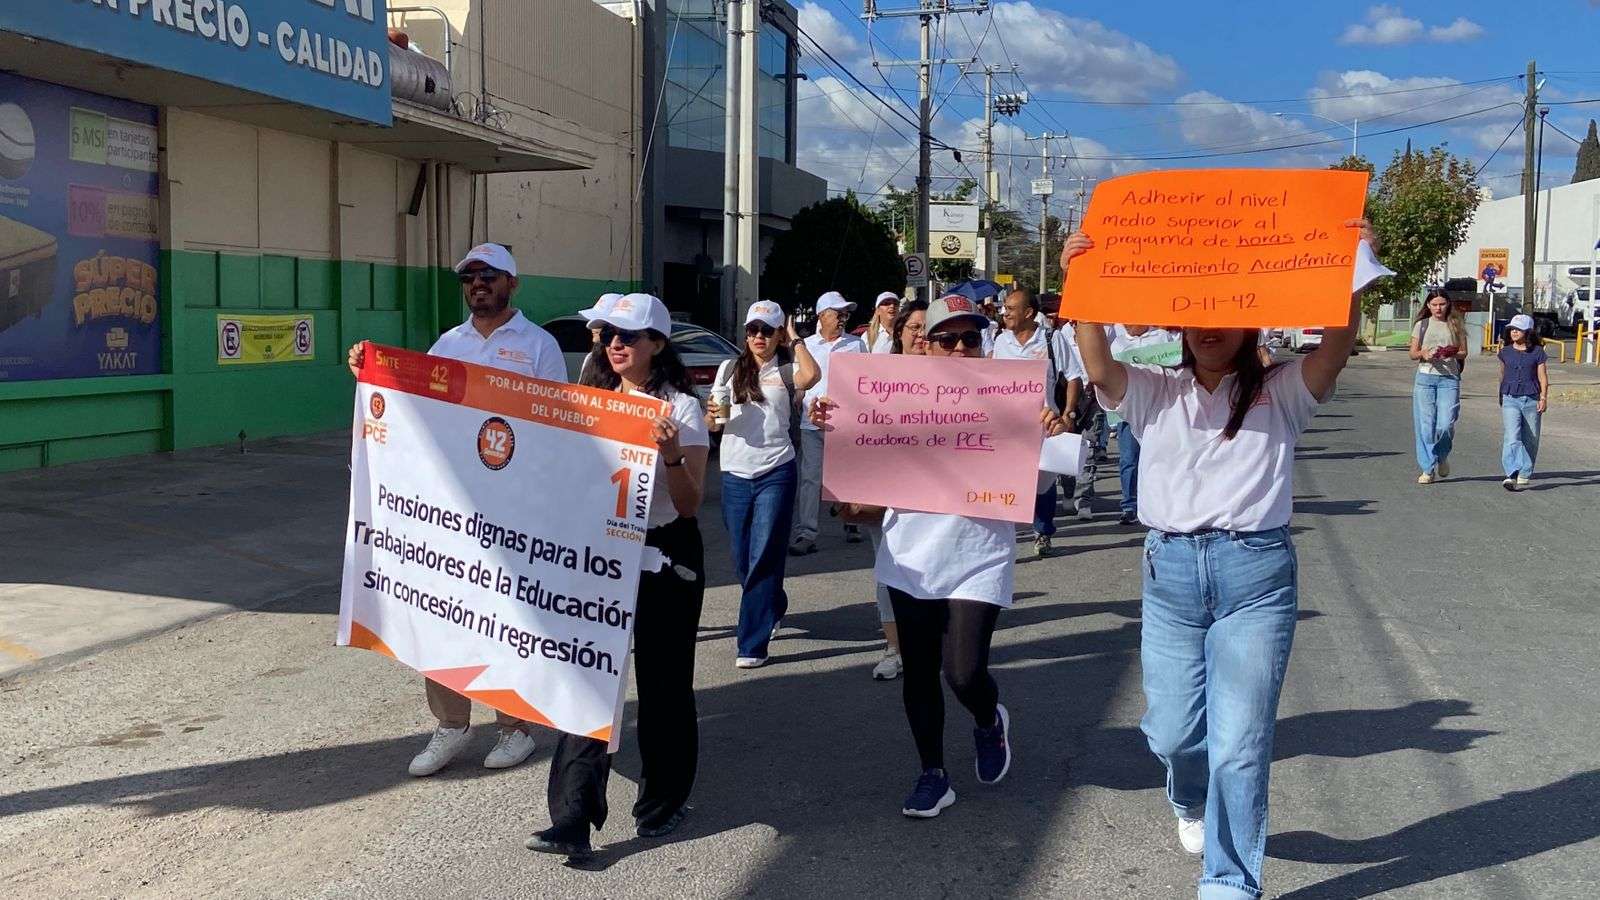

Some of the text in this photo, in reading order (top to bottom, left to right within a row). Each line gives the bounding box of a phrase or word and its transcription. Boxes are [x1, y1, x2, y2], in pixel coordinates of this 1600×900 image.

[277, 21, 383, 87] CALIDAD
[72, 126, 105, 150] 6 MSI
[1121, 189, 1287, 207] Adherir al nivel
[1102, 212, 1277, 235] medio superior al
[1203, 234, 1228, 248] de
[1238, 231, 1295, 246] horas
[1304, 228, 1329, 242] de
[1102, 253, 1352, 276] Fortalecimiento Académico
[73, 286, 158, 328] PRECIO
[97, 352, 138, 370] YAKAT
[431, 365, 448, 383] 42
[512, 380, 525, 392] LA
[526, 383, 587, 404] EDUCACIÓN
[590, 395, 603, 409] AL
[607, 399, 656, 420] SERVICIO
[857, 376, 1044, 405] Exigimos pago inmediato
[531, 403, 550, 418] DEL
[900, 409, 989, 425] instituciones
[362, 423, 388, 446] PCE
[485, 428, 507, 452] 42
[855, 433, 919, 447] deudoras
[926, 433, 946, 447] de
[620, 448, 654, 467] SNTE
[611, 467, 631, 518] 1
[635, 472, 650, 519] MAYO
[378, 483, 623, 580] Pensiones dignas para los
[606, 528, 641, 541] SECCIÓN
[354, 520, 466, 580] Trabajadores
[468, 559, 491, 589] de
[495, 567, 511, 595] la
[363, 567, 619, 676] sin concesión ni regresión.
